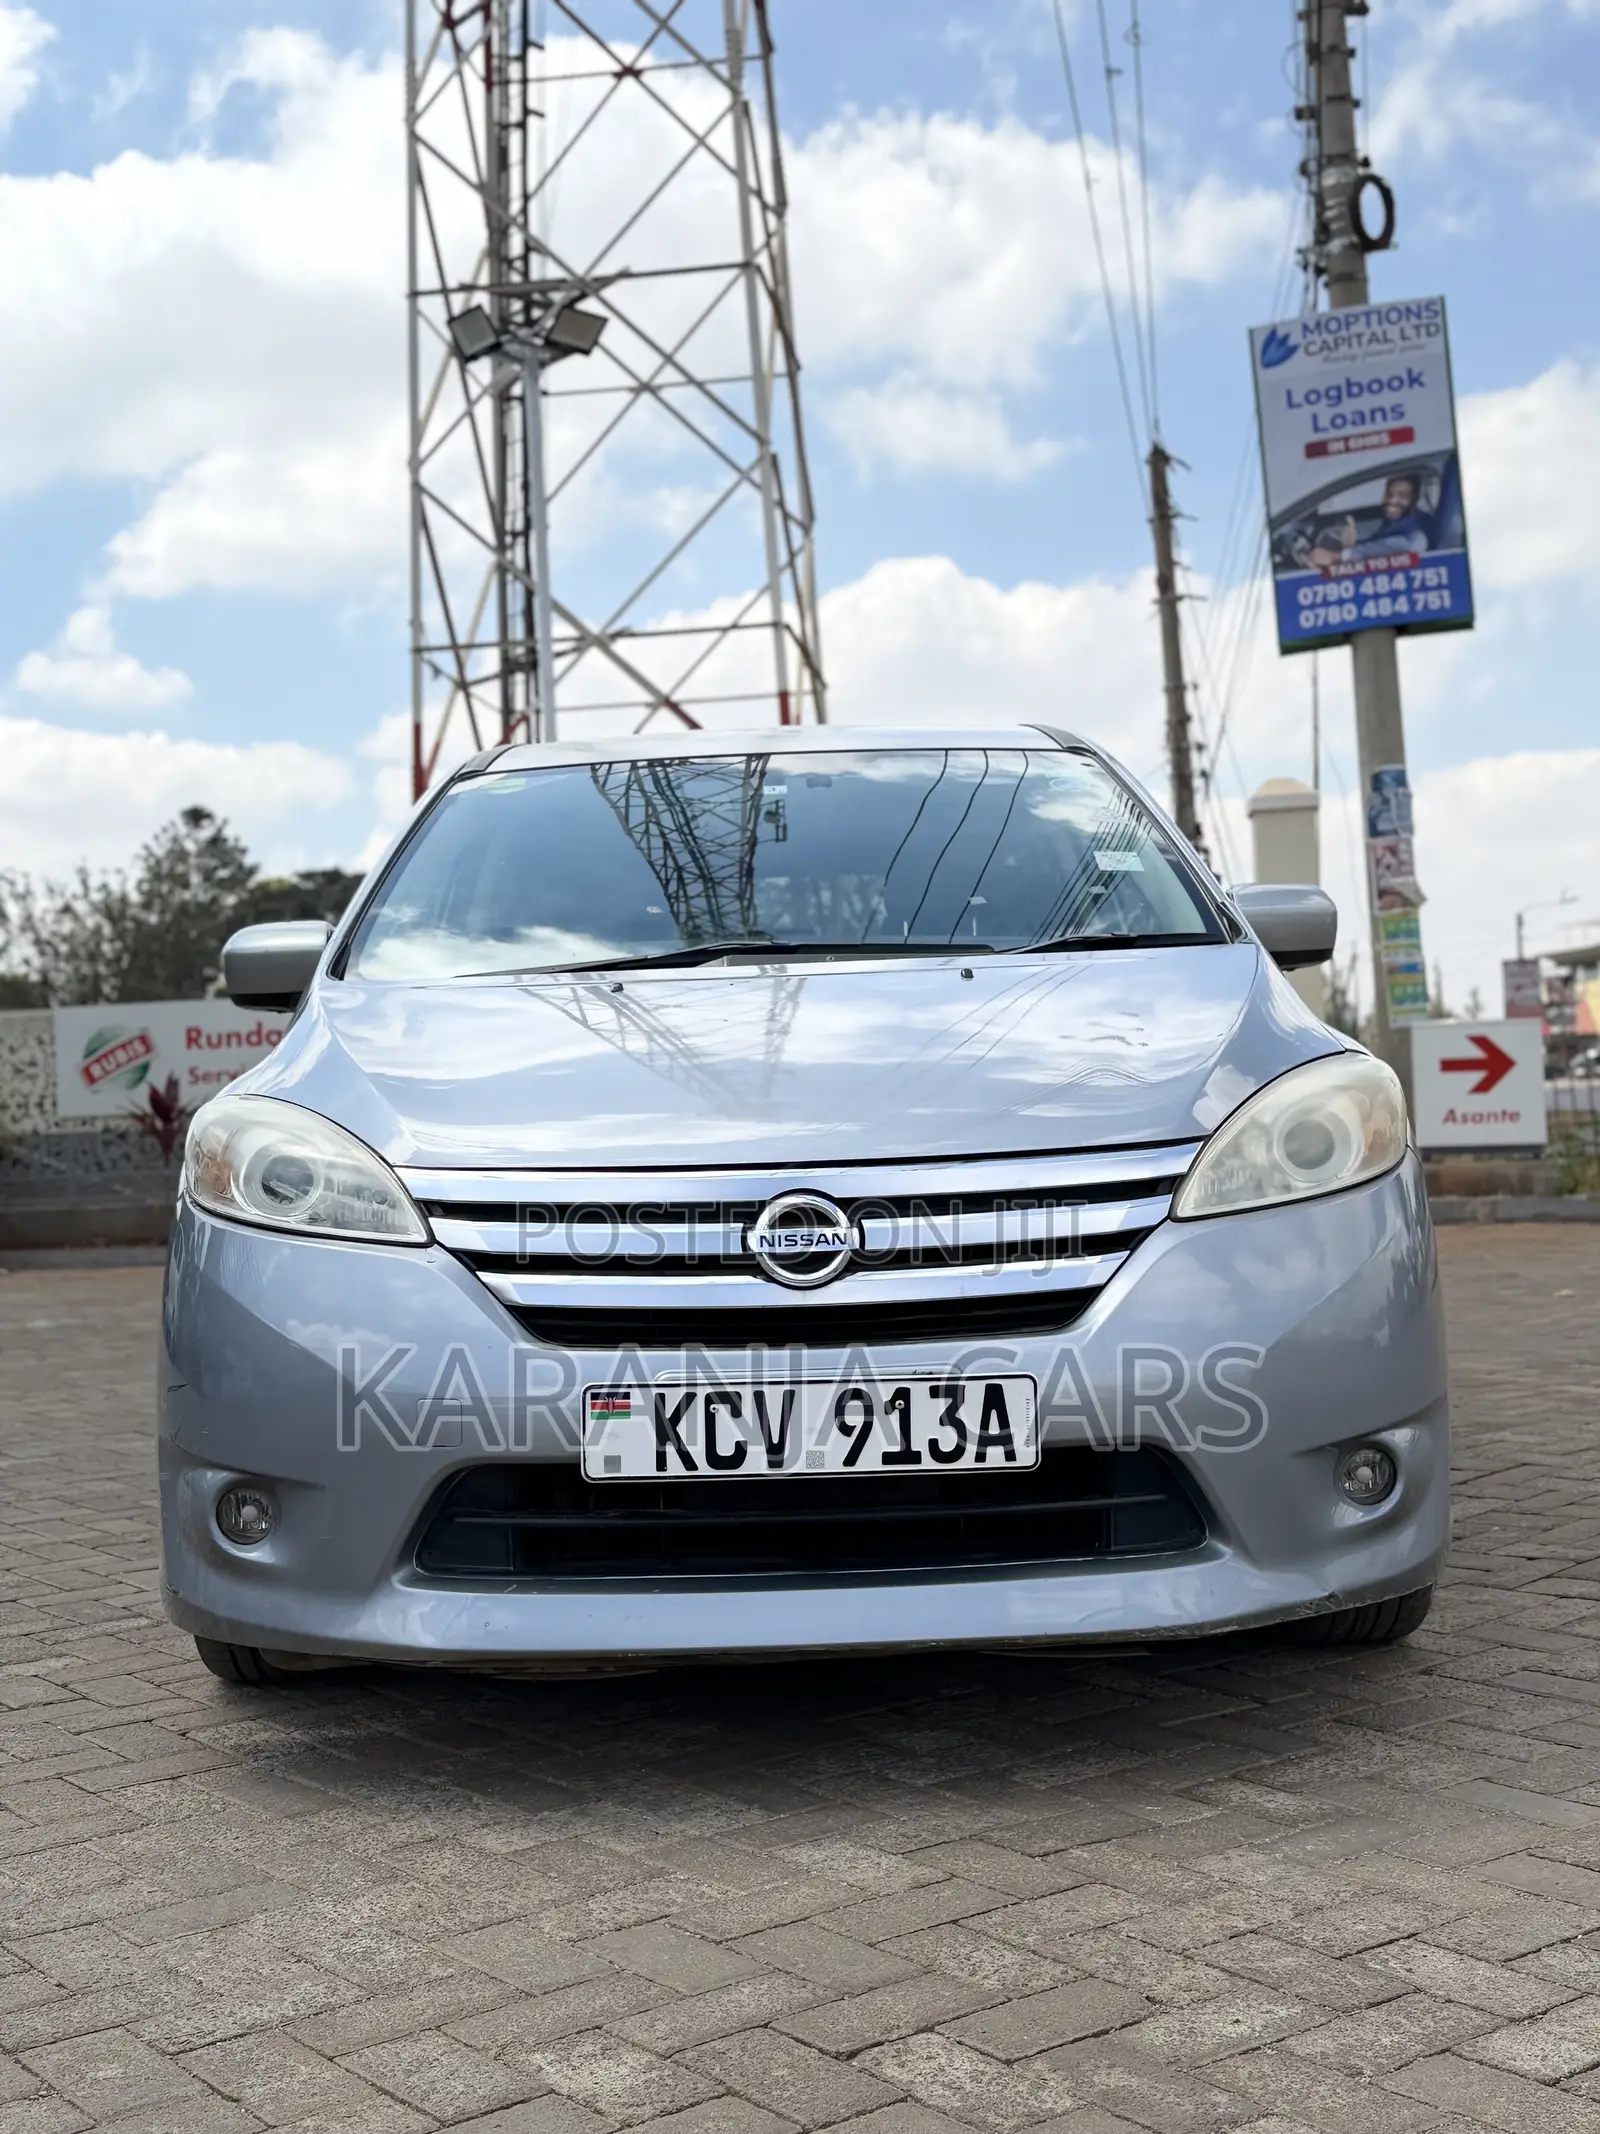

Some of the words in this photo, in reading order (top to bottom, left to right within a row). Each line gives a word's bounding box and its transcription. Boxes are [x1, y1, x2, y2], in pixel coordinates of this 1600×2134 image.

[1302, 302, 1440, 339] MOPTIONS
[1304, 330, 1394, 356] CAPITAL
[1400, 322, 1441, 342] LTD
[1286, 367, 1425, 409] Logbook
[1312, 403, 1406, 433] Loans
[1329, 563, 1366, 577] TALK
[1367, 558, 1388, 571] TO
[1390, 555, 1412, 568] US
[1297, 580, 1355, 605] 0790
[1359, 573, 1408, 595] 484
[1410, 567, 1449, 588] 751
[1299, 602, 1358, 628] 0780
[1362, 595, 1410, 618] 484
[1412, 590, 1451, 611] 751
[88, 1040, 147, 1080] RUBIS
[1442, 1108, 1521, 1126] Asante
[760, 1233, 847, 1248] NISSAN
[654, 1388, 796, 1472] KCV
[834, 1383, 1017, 1467] 913A
